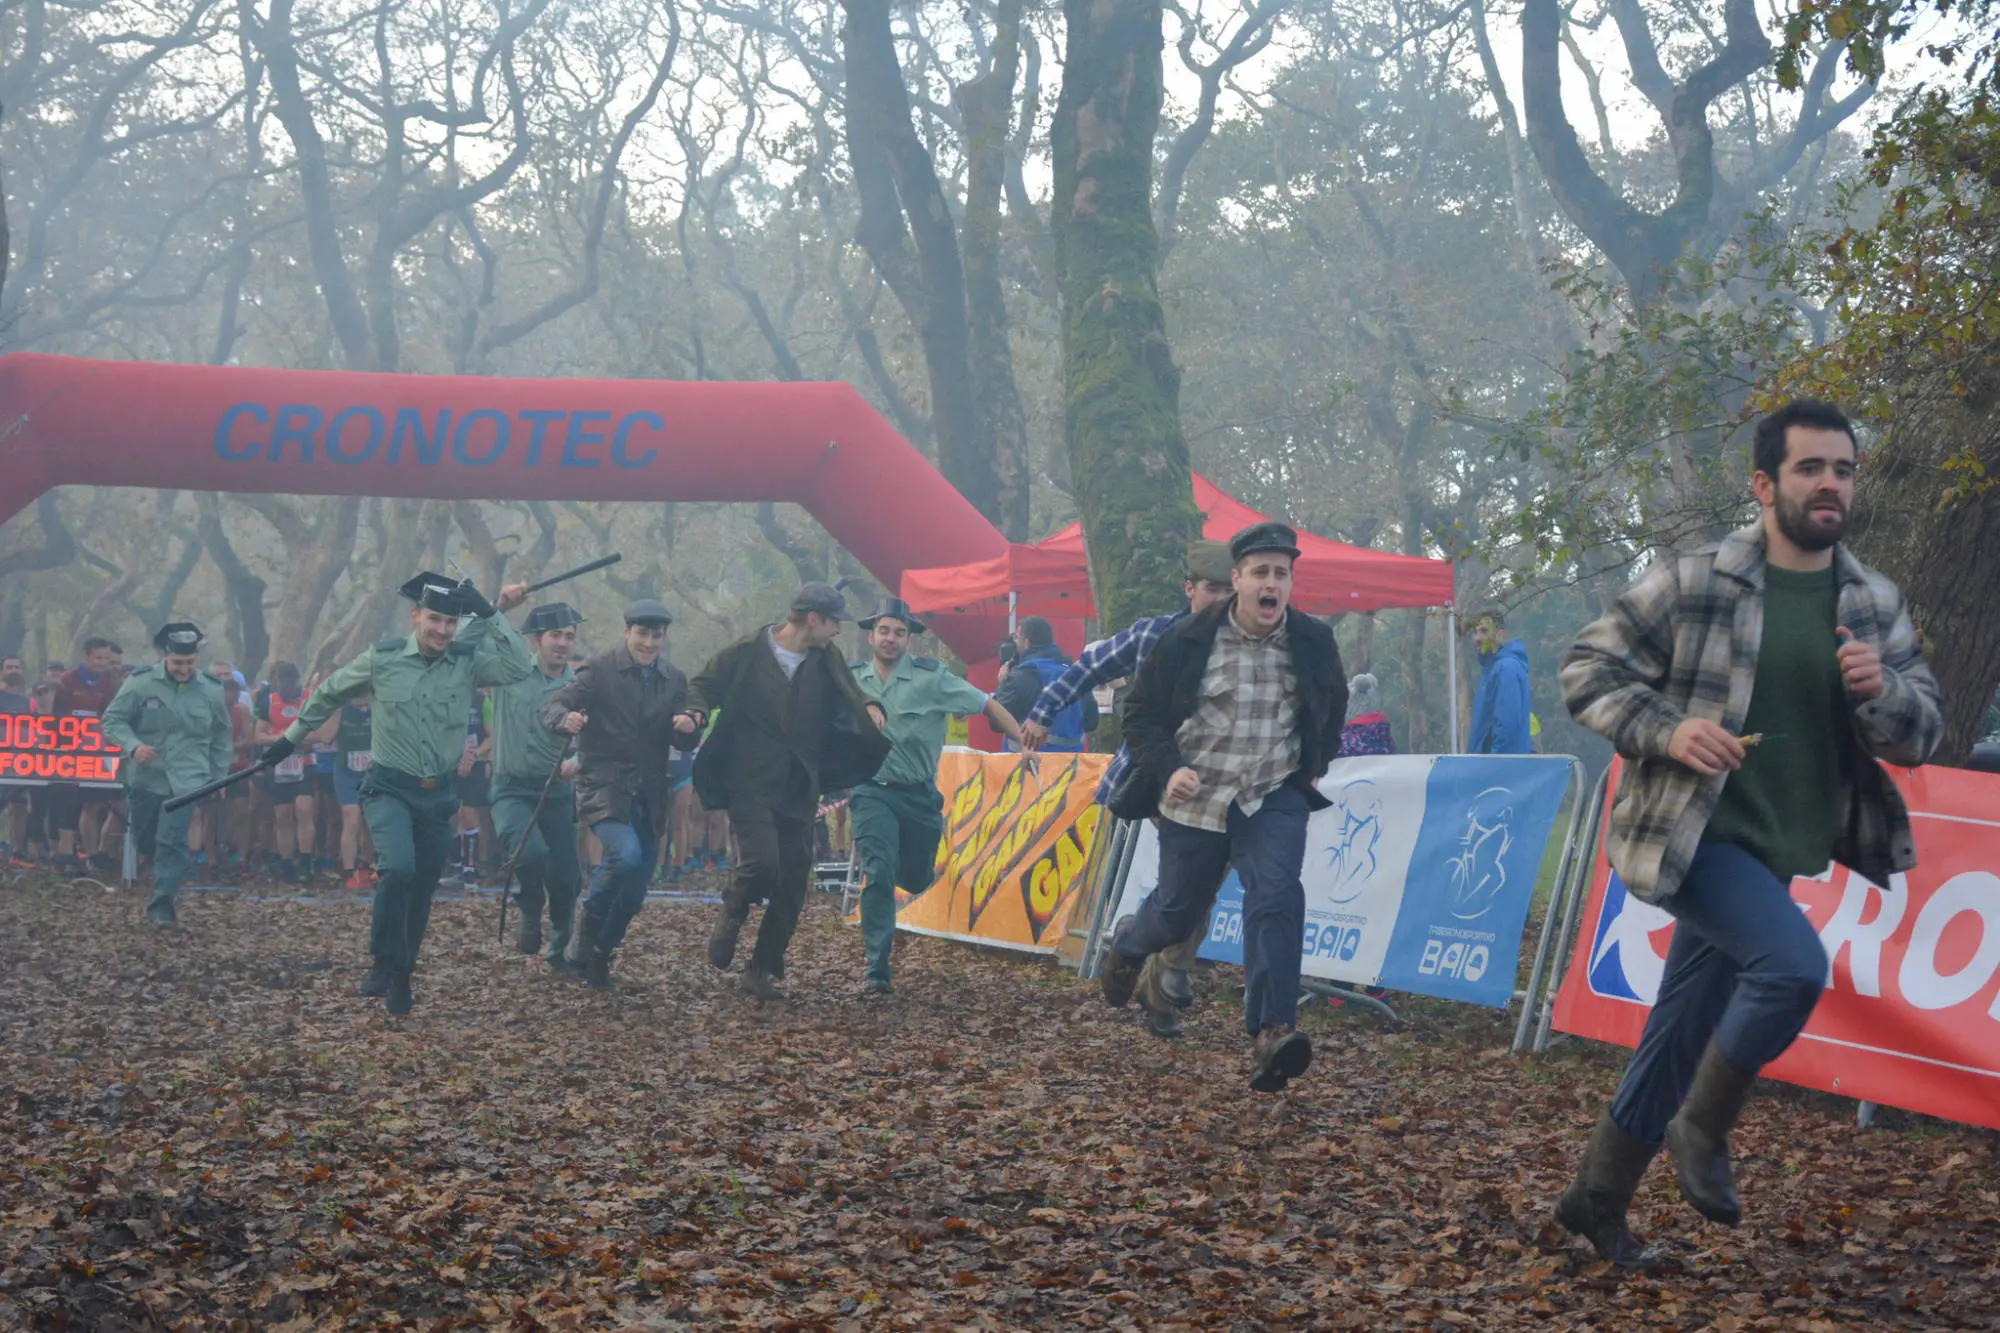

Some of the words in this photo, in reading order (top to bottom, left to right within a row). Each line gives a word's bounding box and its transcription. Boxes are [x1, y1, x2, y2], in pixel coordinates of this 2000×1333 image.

[213, 402, 665, 469] CRONOTEC
[1211, 911, 1244, 945] BAI
[1302, 922, 1361, 962] BAIO
[1418, 939, 1490, 982] BAIO
